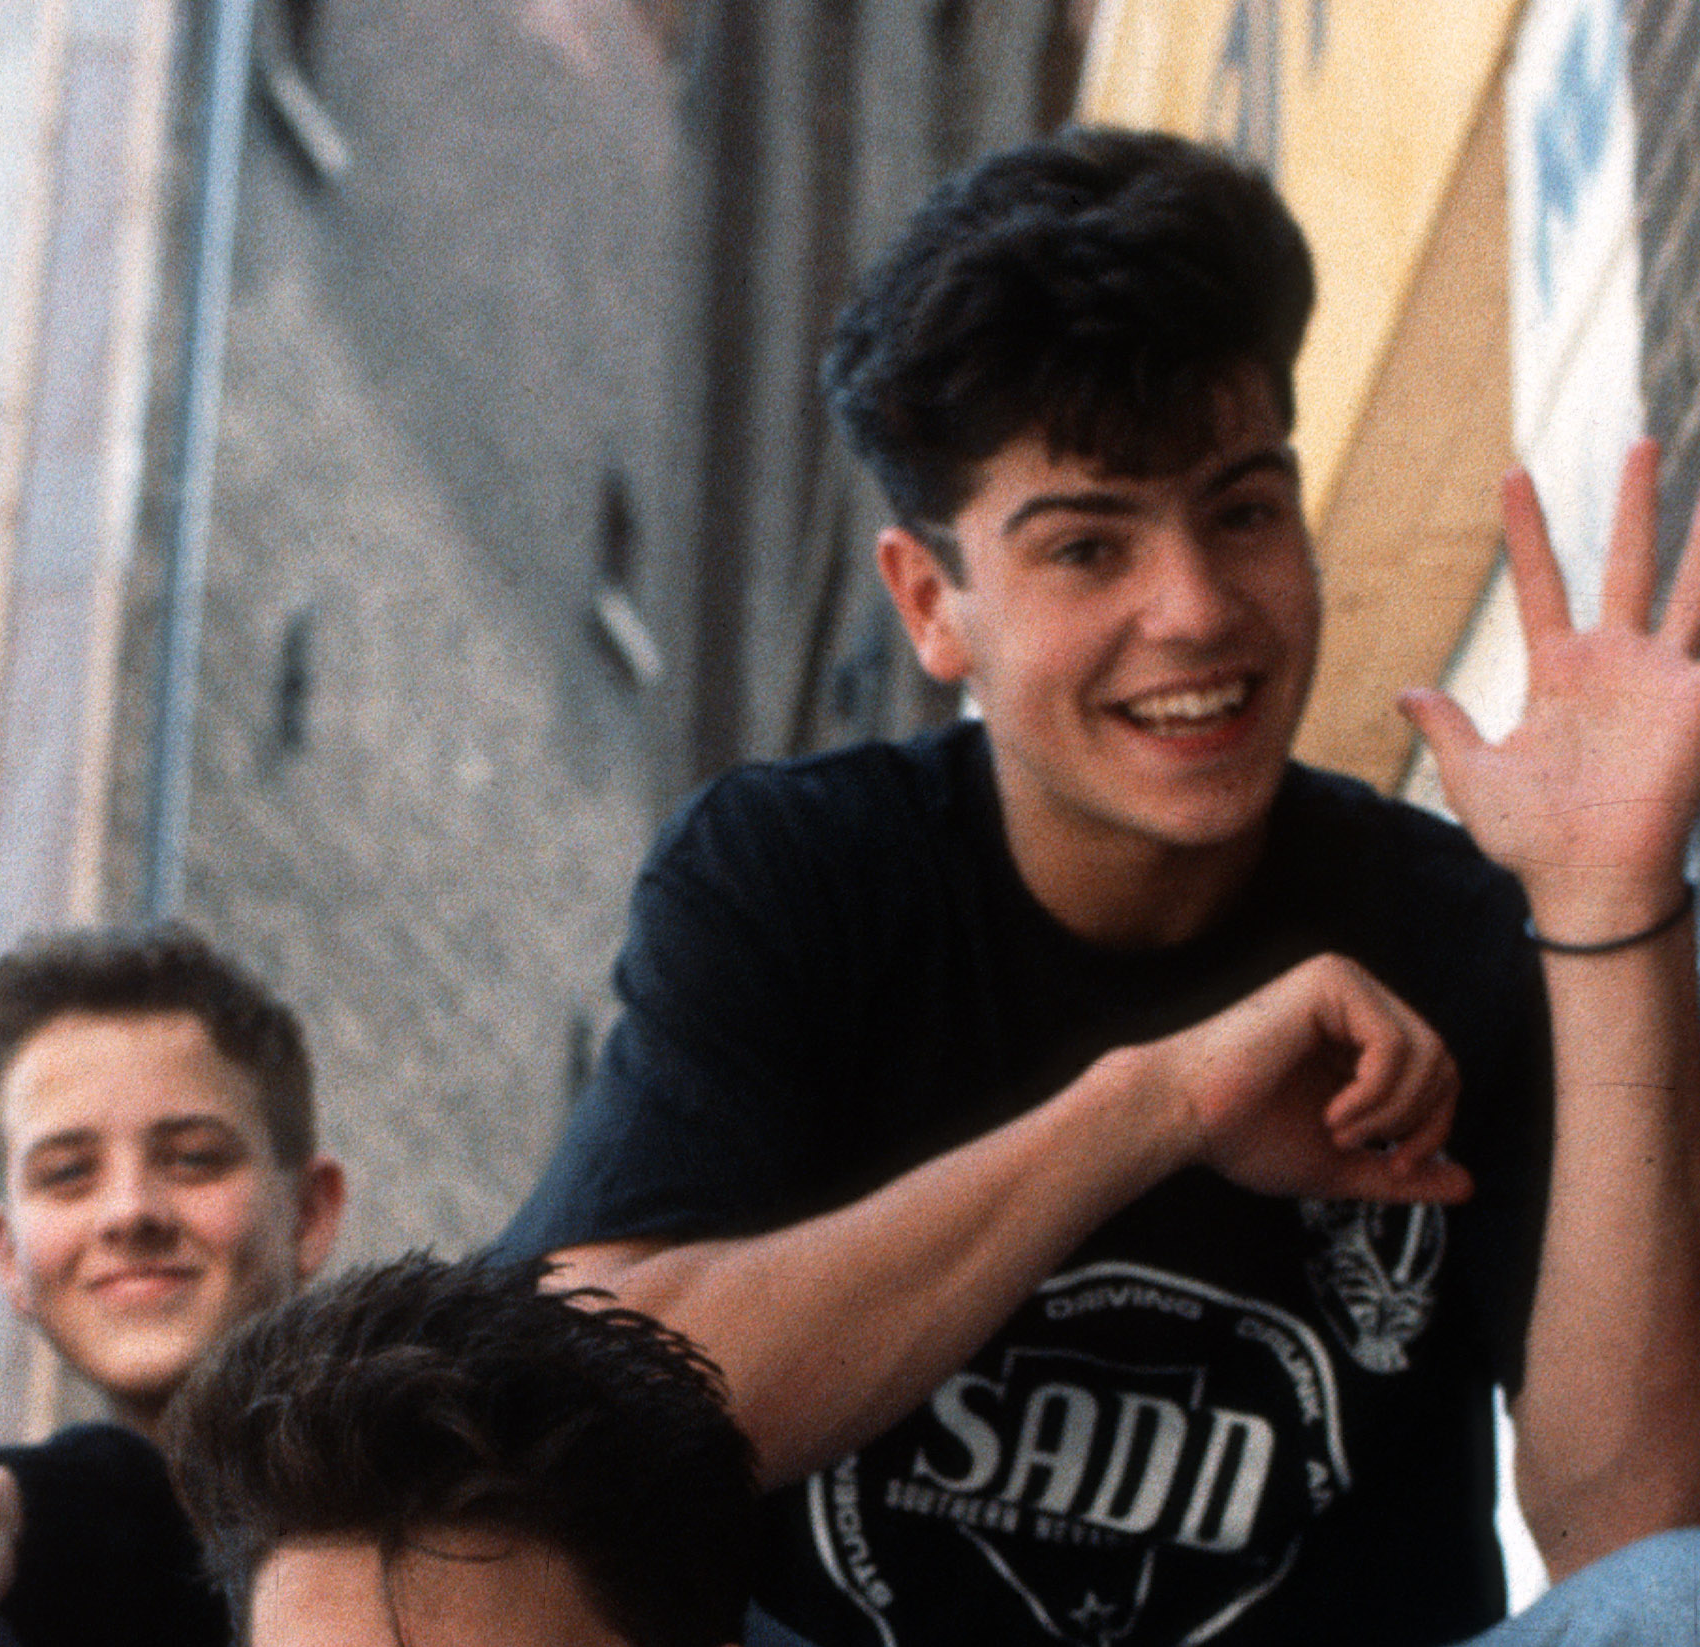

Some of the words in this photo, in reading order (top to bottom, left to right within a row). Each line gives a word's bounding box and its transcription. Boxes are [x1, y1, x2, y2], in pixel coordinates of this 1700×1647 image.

[1044, 1287, 1204, 1321] DRIVING
[913, 1374, 1277, 1553] SADD
[884, 1478, 1021, 1534] SOUTHERN
